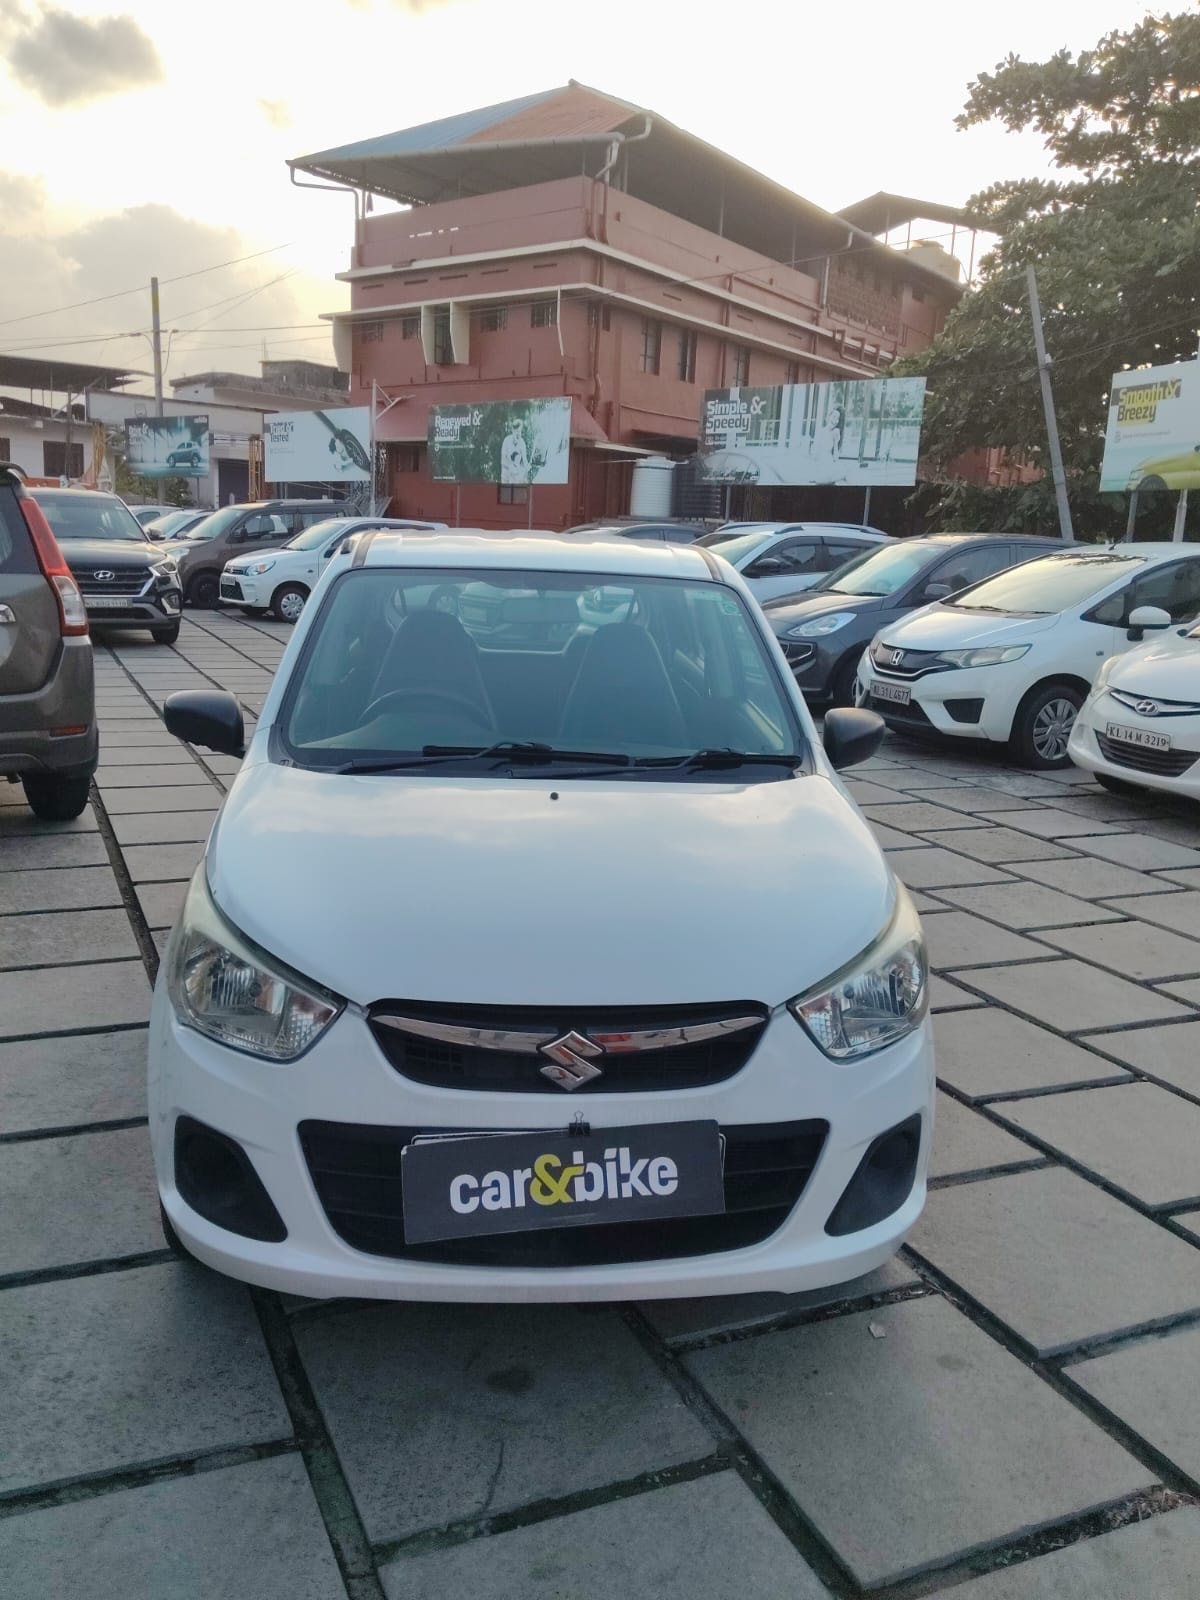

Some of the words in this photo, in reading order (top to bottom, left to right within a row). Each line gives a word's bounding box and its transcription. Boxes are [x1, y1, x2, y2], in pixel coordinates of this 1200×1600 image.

[1119, 384, 1161, 405] Smooth
[707, 400, 748, 415] Simple
[750, 396, 767, 414] &
[1117, 405, 1157, 423] Breezy
[435, 415, 471, 427] Renewed
[473, 411, 483, 425] &
[707, 414, 750, 432] Speedy
[435, 426, 459, 441] Ready
[1109, 726, 1121, 738] KL
[1124, 729, 1133, 740] 14
[1135, 732, 1143, 743] M
[1144, 734, 1167, 747] 3219
[449, 1146, 679, 1215] car&bike
